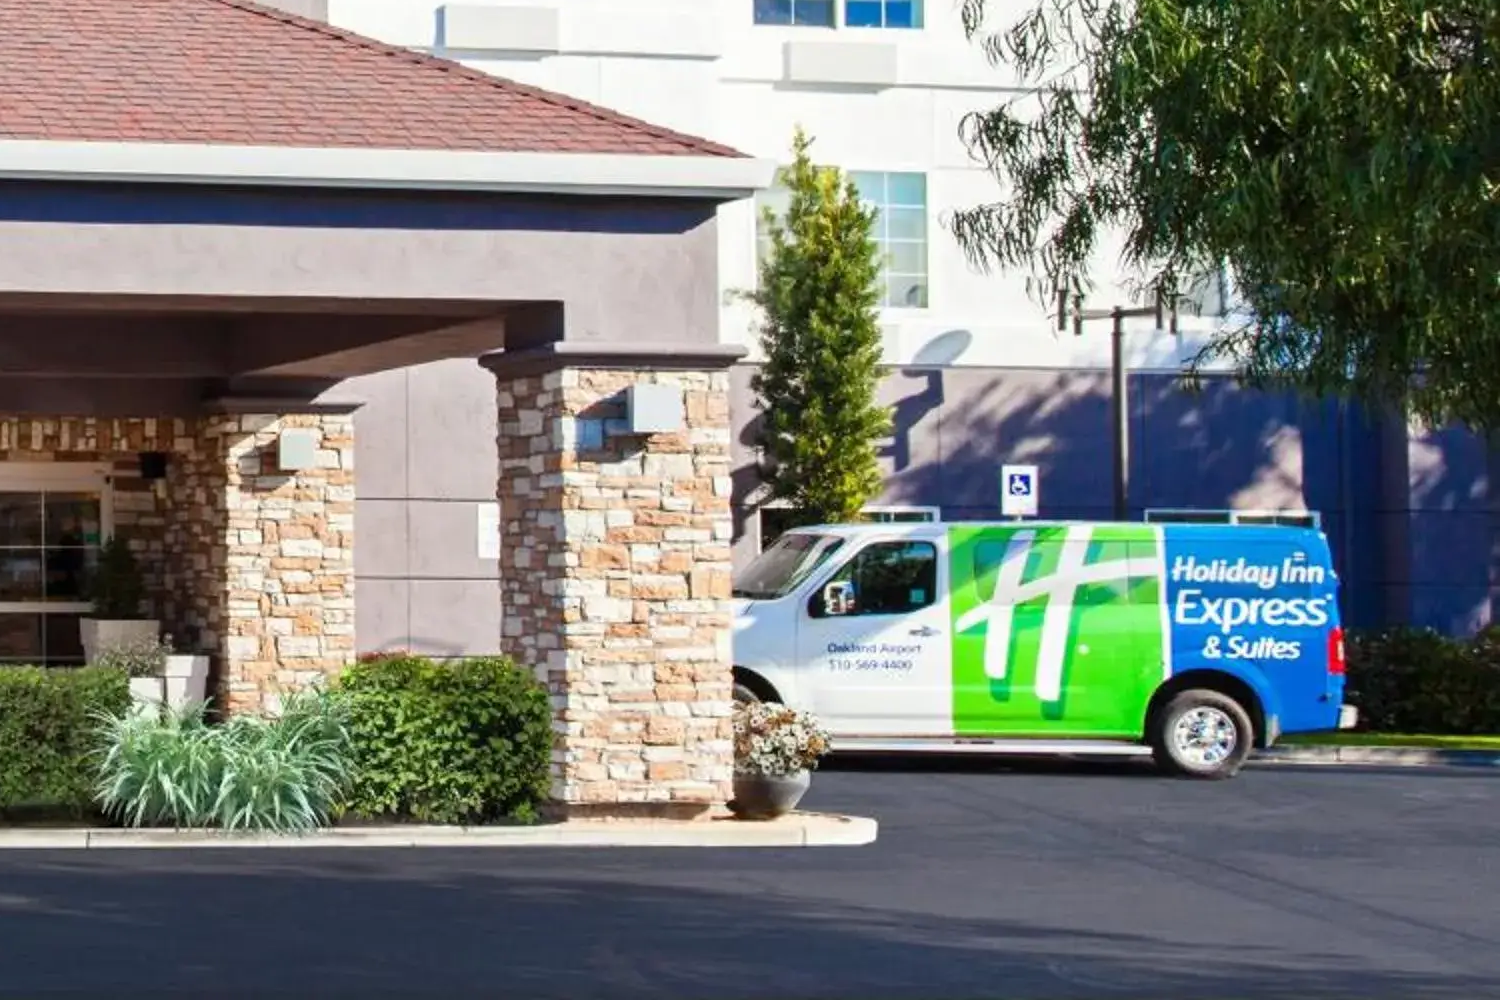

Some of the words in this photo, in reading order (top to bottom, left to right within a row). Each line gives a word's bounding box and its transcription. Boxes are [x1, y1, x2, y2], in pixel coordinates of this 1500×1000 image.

[1172, 555, 1278, 589] Holiday
[1281, 557, 1325, 584] Inn
[1175, 589, 1328, 634] Express
[827, 642, 877, 653] Oakland
[880, 643, 921, 655] Airport
[1202, 635, 1222, 659] &
[1225, 635, 1301, 659] Suites
